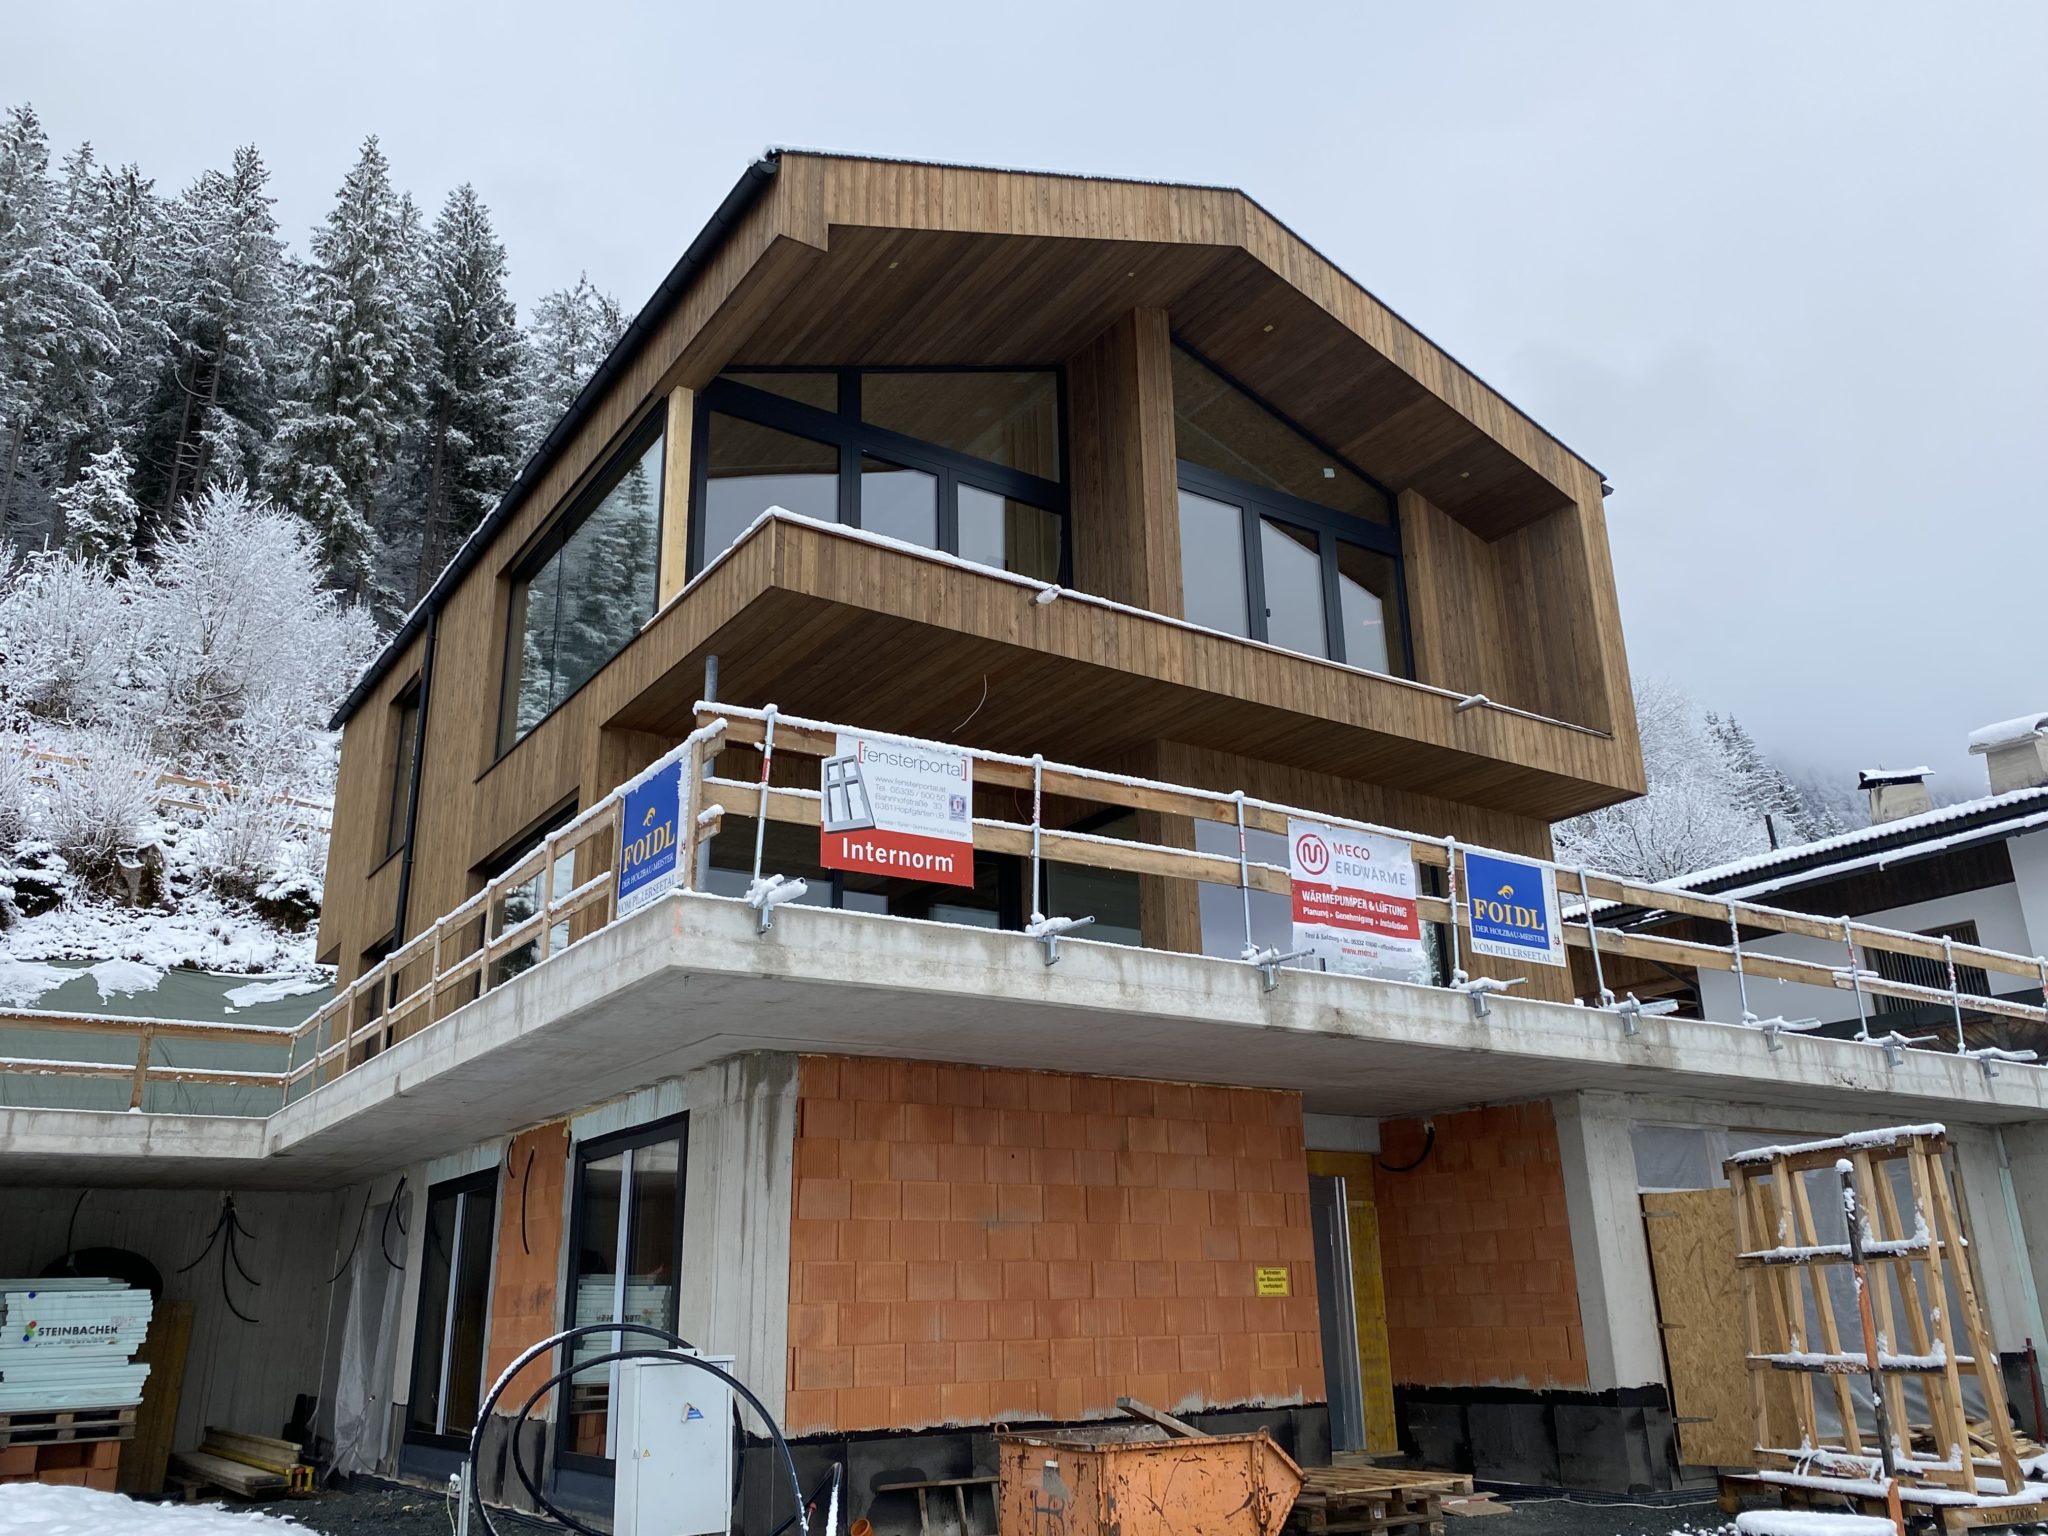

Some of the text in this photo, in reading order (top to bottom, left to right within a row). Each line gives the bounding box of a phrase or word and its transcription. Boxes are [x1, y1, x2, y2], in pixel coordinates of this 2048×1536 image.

[875, 776, 946, 793] www.fensterportal.at
[875, 793, 928, 808] Bahnhofstraße
[622, 820, 676, 874] FOIDL
[842, 837, 953, 873] Internorm
[1332, 842, 1370, 861] MECO
[622, 852, 674, 890] DER HOLZBAU-MEISTER
[1335, 861, 1407, 886] ERDWÄRME
[1302, 889, 1407, 918] WÄRMEPUMPEN & LÜFTUNG
[1472, 898, 1545, 931] FOIDL
[1303, 907, 1408, 931] Planung Genehmigung Installation
[1475, 925, 1546, 943] DER HOLZBAU-MEISTER
[1473, 942, 1552, 963] VOM PILLERSEETAL
